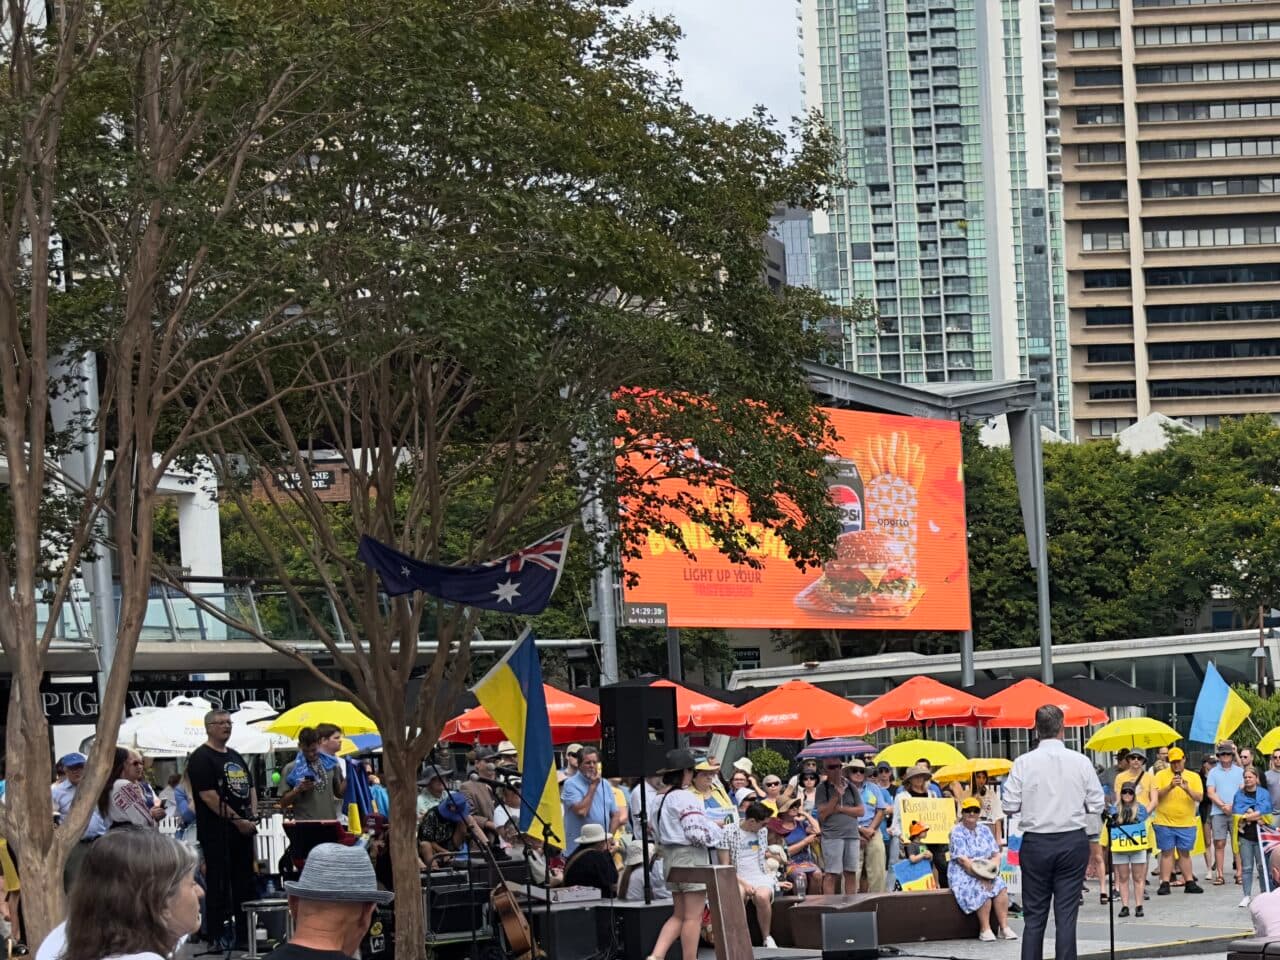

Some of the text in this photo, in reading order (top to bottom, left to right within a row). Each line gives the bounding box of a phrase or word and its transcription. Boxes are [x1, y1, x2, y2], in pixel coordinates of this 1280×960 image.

[278, 471, 330, 481] BISNE
[284, 481, 328, 489] ACDE.
[838, 508, 860, 521] PSI
[877, 518, 909, 527] oporto
[683, 568, 762, 583] LIGHT UP YOUR
[41, 691, 98, 716] PIG
